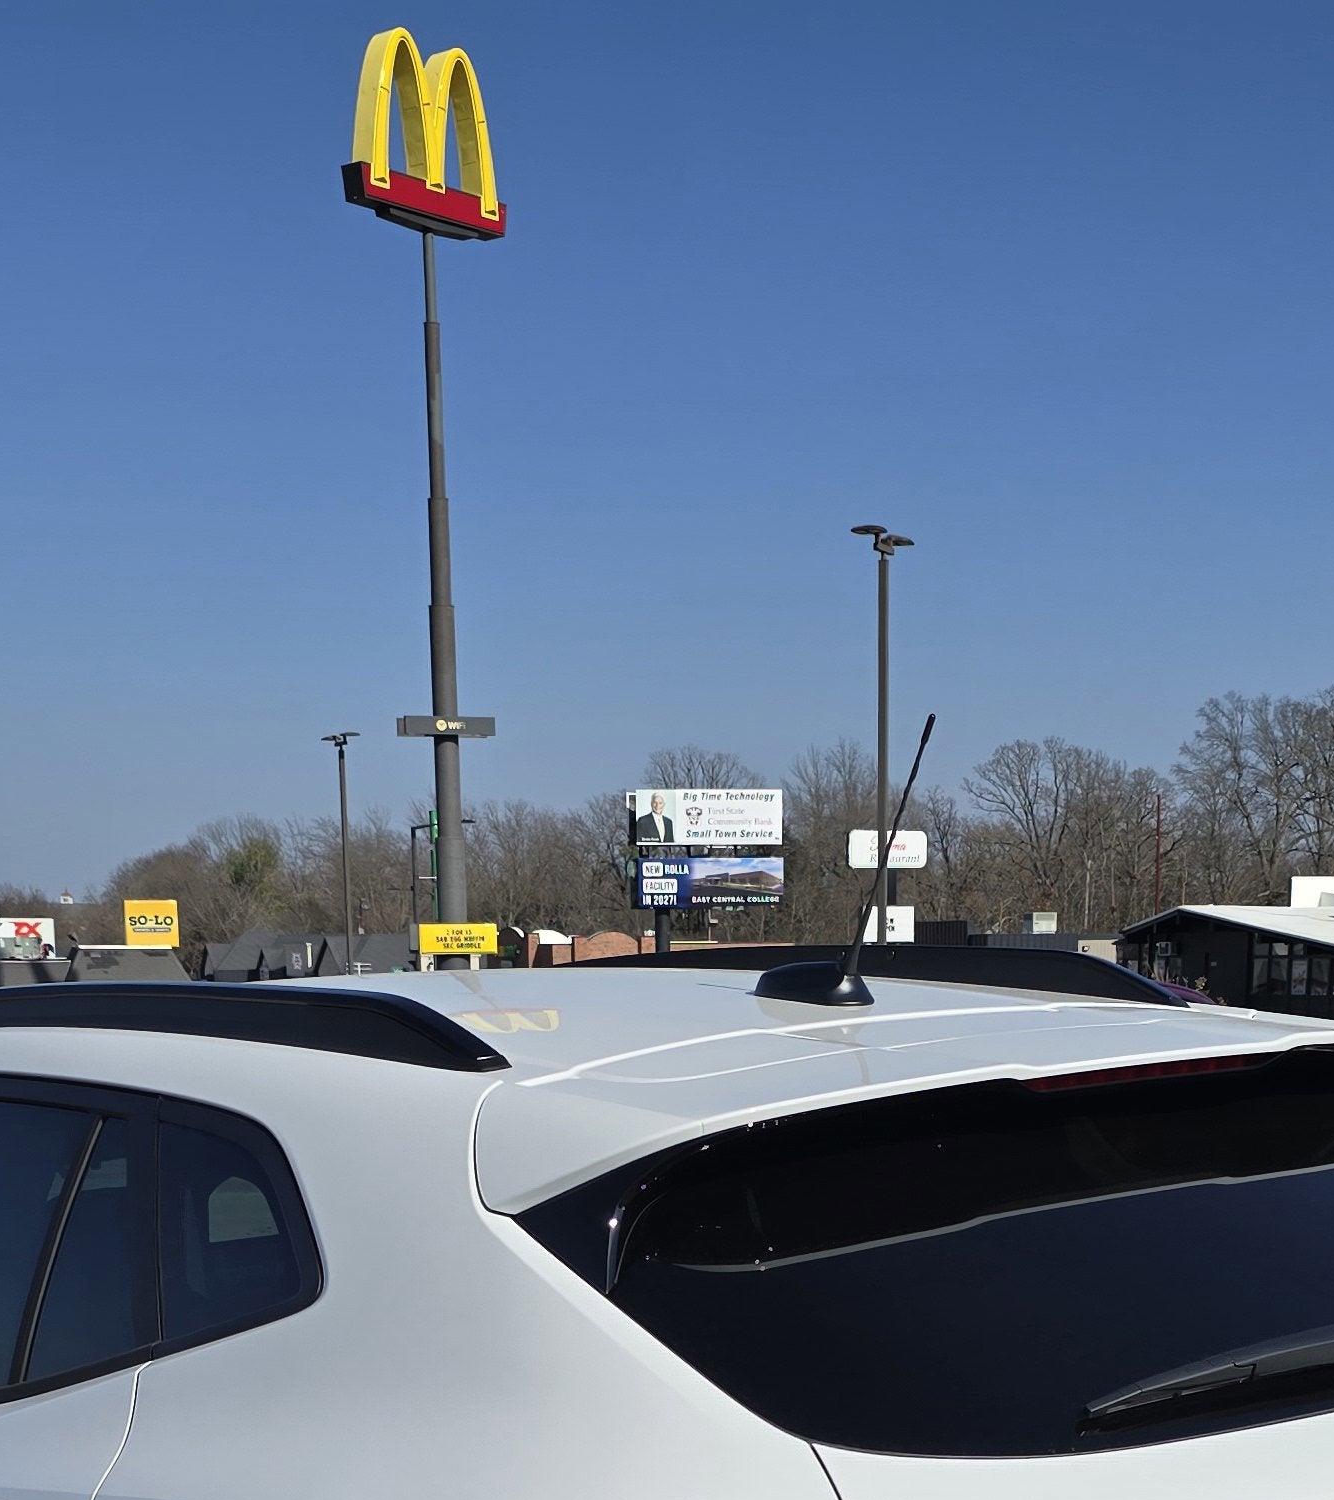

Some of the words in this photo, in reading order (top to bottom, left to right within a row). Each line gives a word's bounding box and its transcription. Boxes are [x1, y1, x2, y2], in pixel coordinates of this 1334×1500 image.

[683, 792, 698, 802] Big
[701, 792, 722, 801] Time
[725, 792, 775, 802] Technology
[686, 830, 712, 838] Small
[715, 830, 737, 838] Town
[740, 829, 773, 838] Service
[645, 865, 661, 875] NEW
[664, 864, 690, 875] ROLLA
[645, 881, 675, 891] FACILITY
[642, 895, 652, 905] IN
[747, 895, 780, 903] COLLEGE
[129, 915, 174, 926] SO-LO
